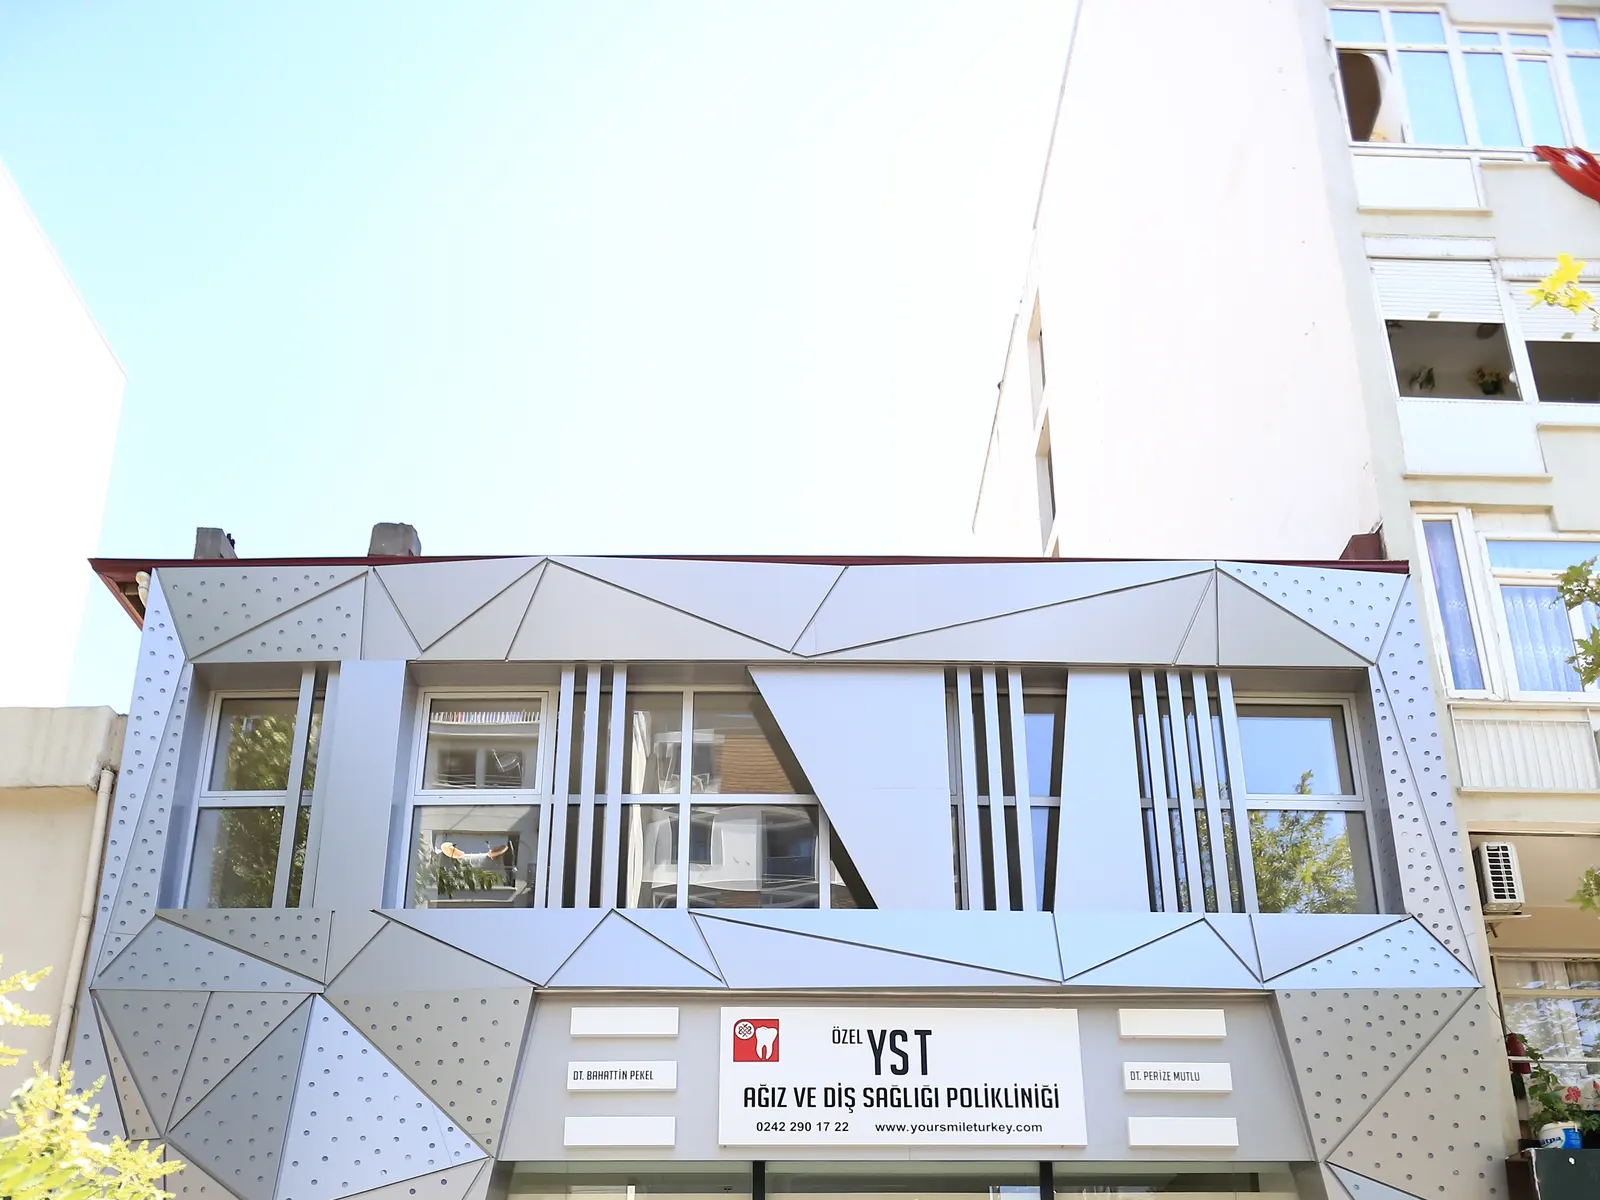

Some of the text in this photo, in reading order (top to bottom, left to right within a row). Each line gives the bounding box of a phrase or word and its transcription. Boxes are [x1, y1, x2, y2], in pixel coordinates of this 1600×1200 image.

[832, 1026, 932, 1076] ÖZEL YST
[573, 1069, 654, 1080] DT. BAHATTİN PEKEL
[1130, 1070, 1200, 1082] DT. PERİZE MUTLU
[743, 1083, 1059, 1114] AĞIZ VE DİŞ SAĞLIĞI POLİKLİNİĞİ
[756, 1121, 849, 1132] 0242 290 17 22
[875, 1121, 1043, 1135] www.yoursmileturkey.com
